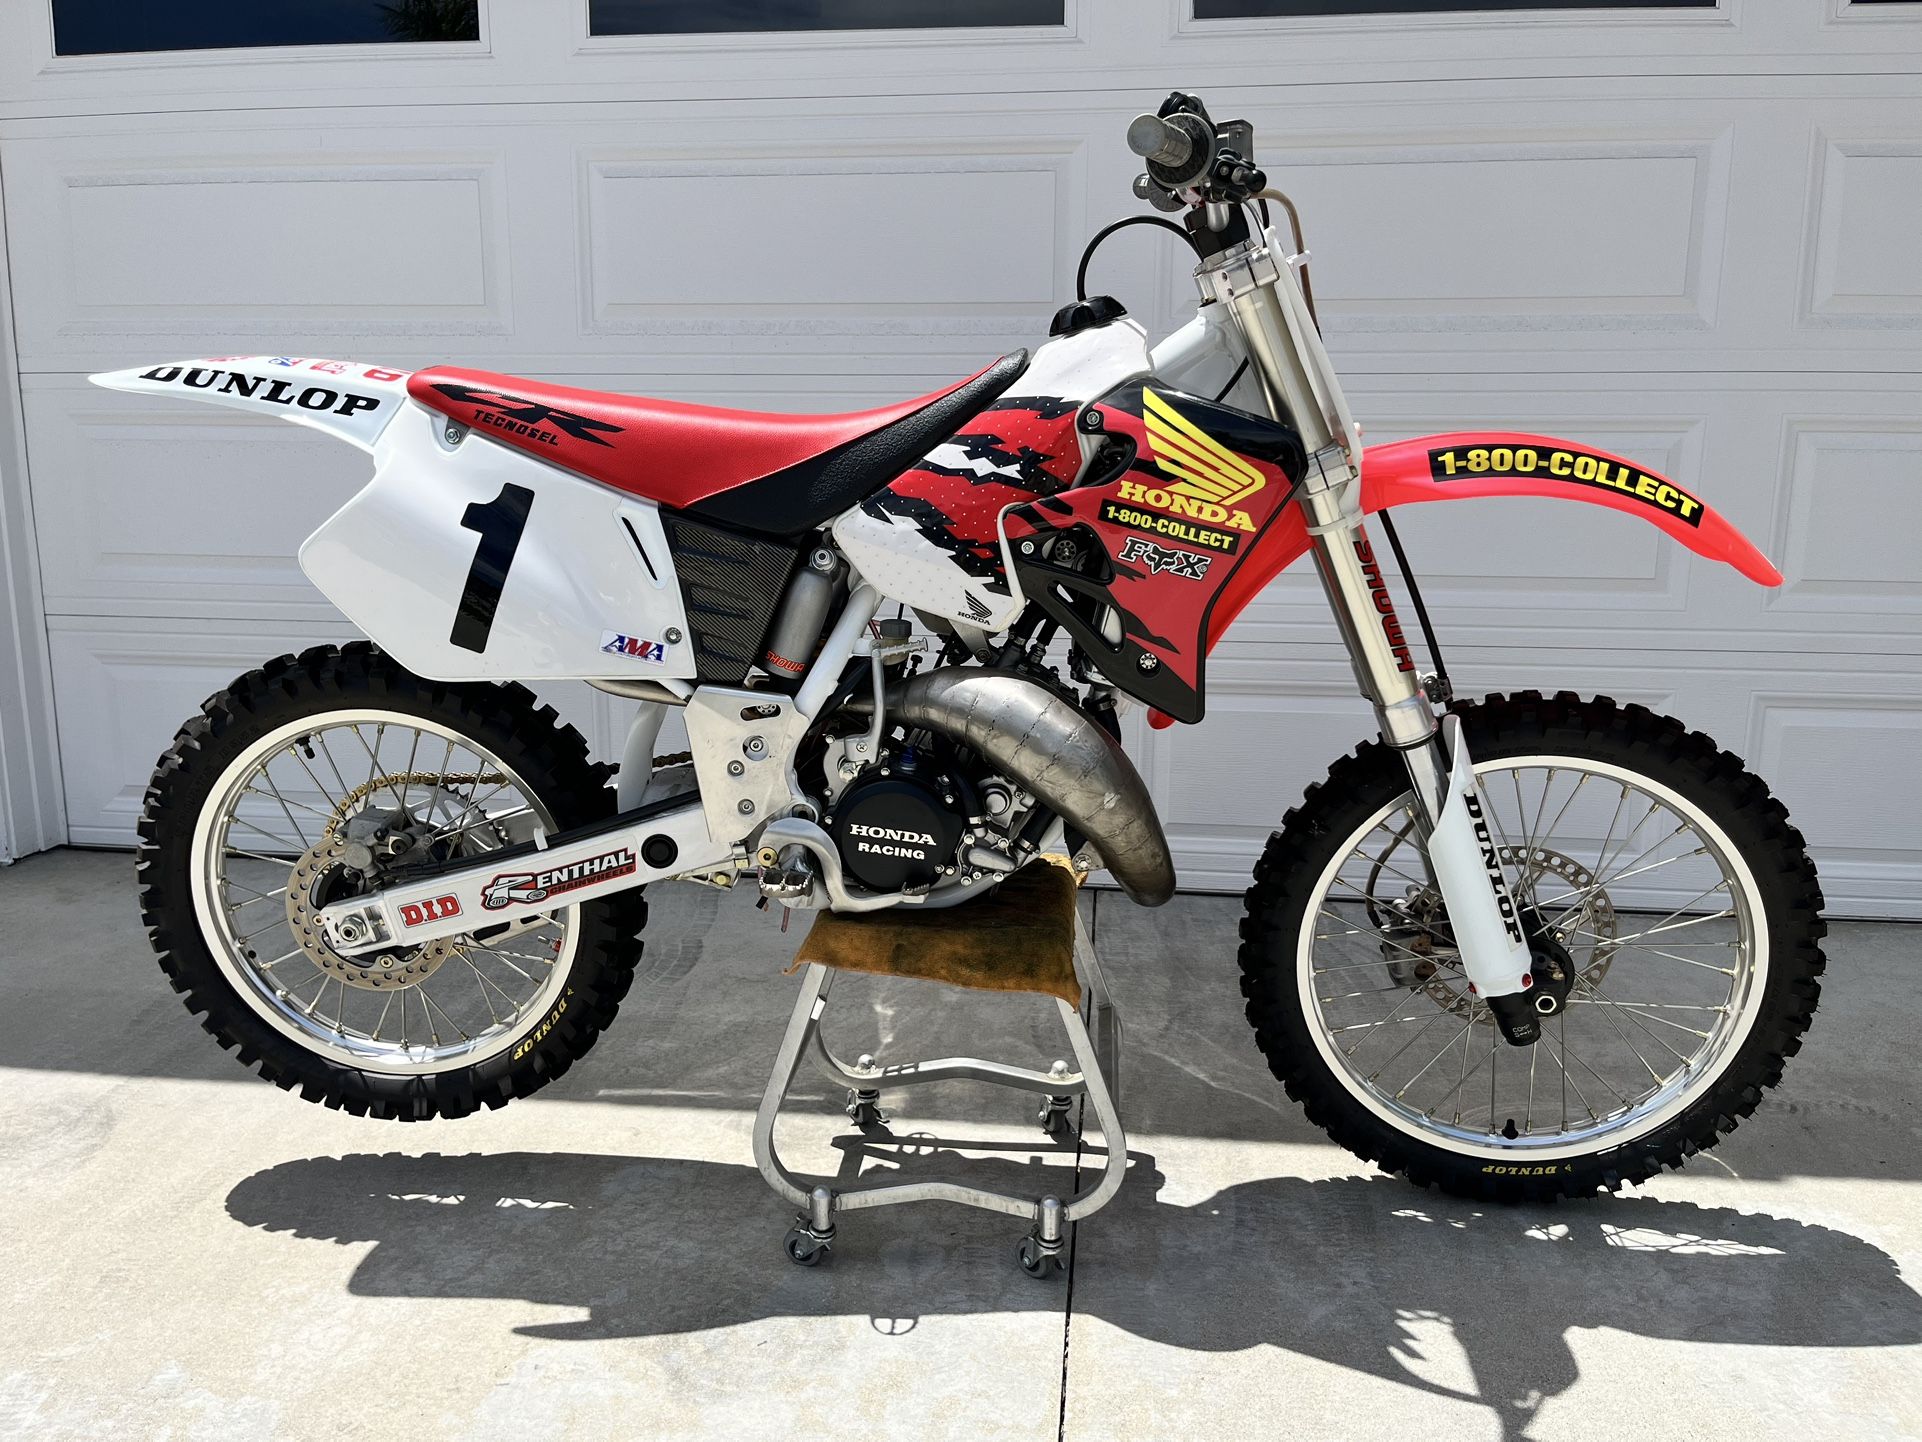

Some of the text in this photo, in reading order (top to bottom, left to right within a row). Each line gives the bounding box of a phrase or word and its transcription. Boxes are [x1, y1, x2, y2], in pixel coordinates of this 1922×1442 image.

[139, 366, 381, 417] DUNLOP
[473, 408, 559, 447] TECNOSEL
[1437, 447, 1700, 519] 1-800-COLLECT
[1116, 480, 1257, 533] HONDA
[1106, 505, 1234, 550] 1-800-COLLECT
[449, 482, 536, 655] 1
[957, 610, 992, 626] HONDA
[1352, 539, 1416, 673] SHOWA
[600, 633, 665, 663] AMA
[765, 650, 806, 673] SHOWA
[849, 823, 937, 846] HONDA
[857, 842, 926, 860] RACING
[549, 865, 634, 895] CHAINWHEELS
[1463, 792, 1523, 945] DUNLOP
[400, 896, 460, 926] D.I.D
[513, 997, 568, 1061] DUNLOP
[1481, 1164, 1558, 1176] DUNLOP
